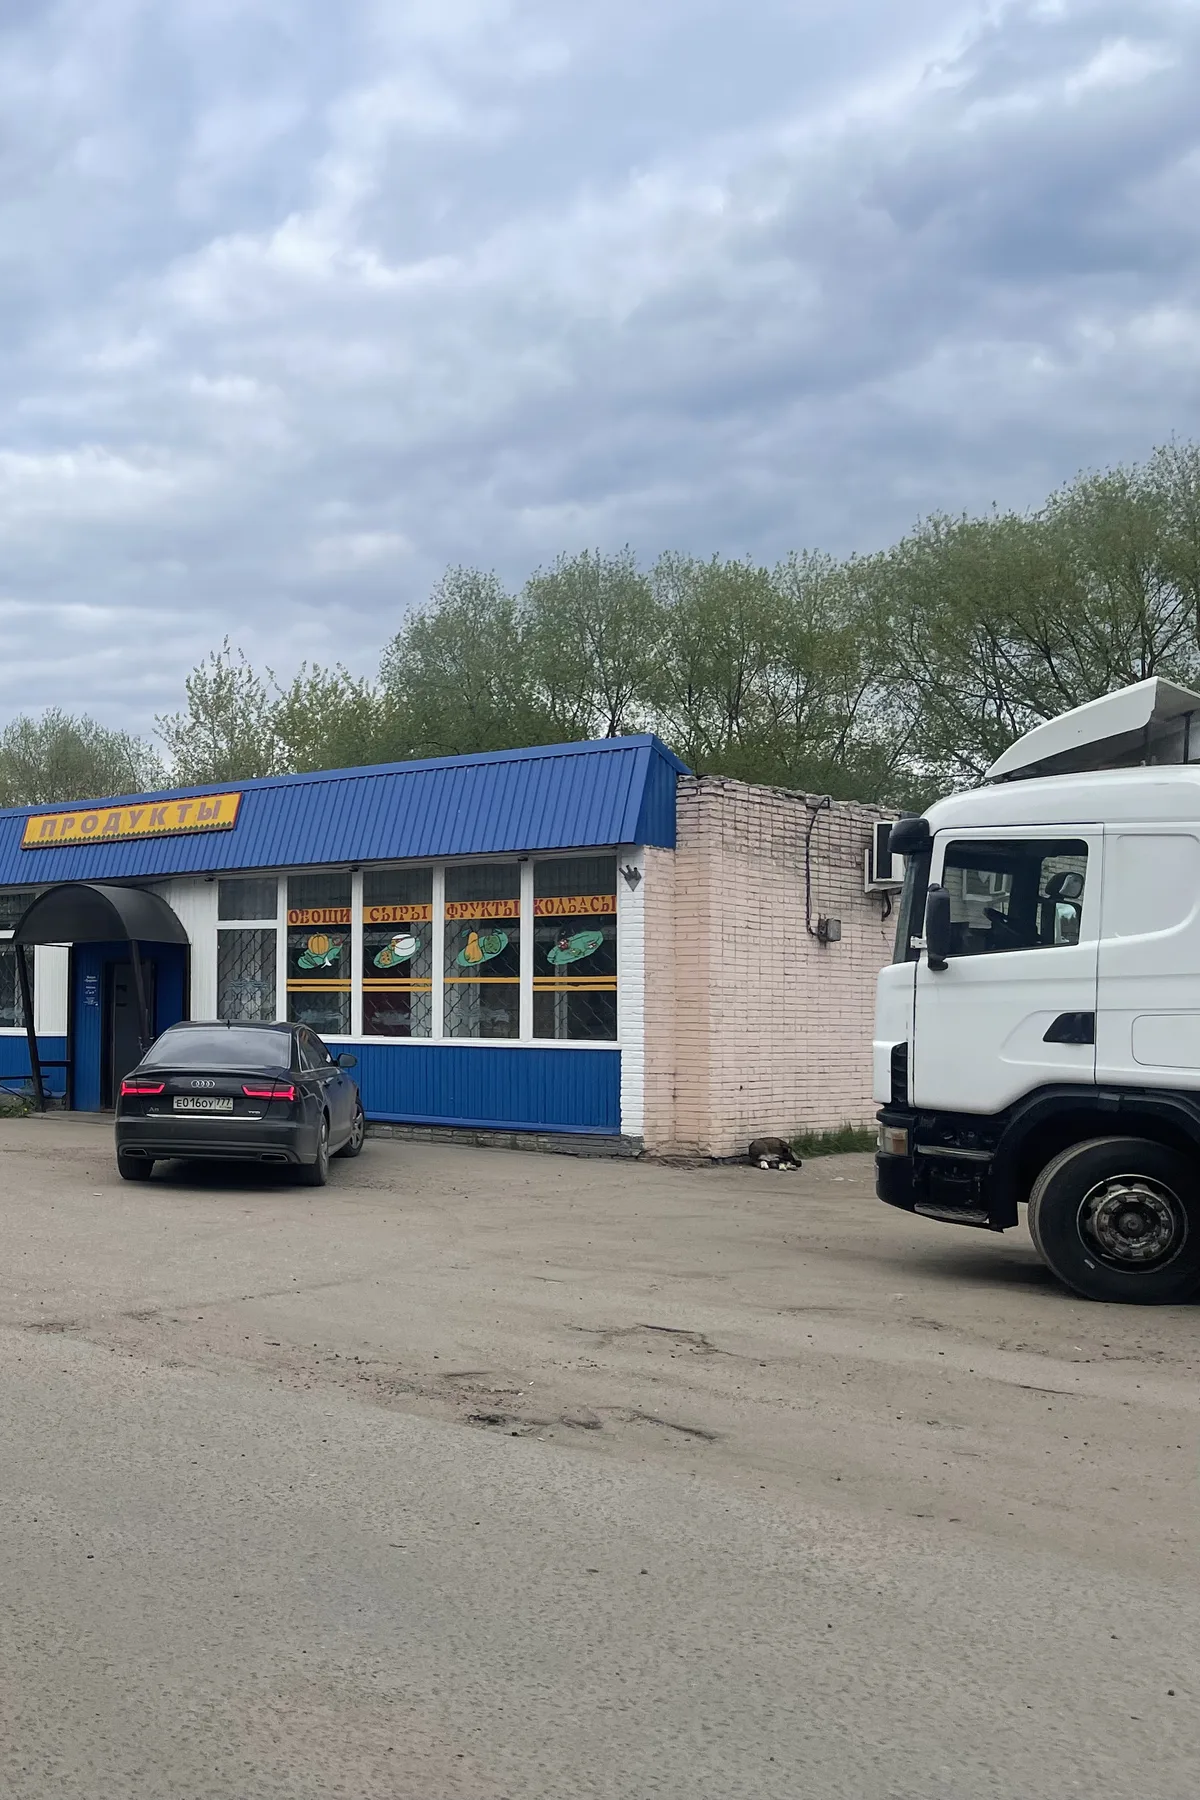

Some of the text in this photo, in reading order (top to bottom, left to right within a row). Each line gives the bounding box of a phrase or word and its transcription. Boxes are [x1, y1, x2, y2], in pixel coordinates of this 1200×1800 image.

[39, 800, 222, 838] ПРОДУКТЫ
[446, 900, 520, 918] ФРУКТЫ
[533, 895, 616, 915] КОЛБАСЫ
[289, 909, 351, 924] ОВОЩИ
[369, 906, 428, 921] СЫРЫ
[216, 1097, 231, 1106] 777
